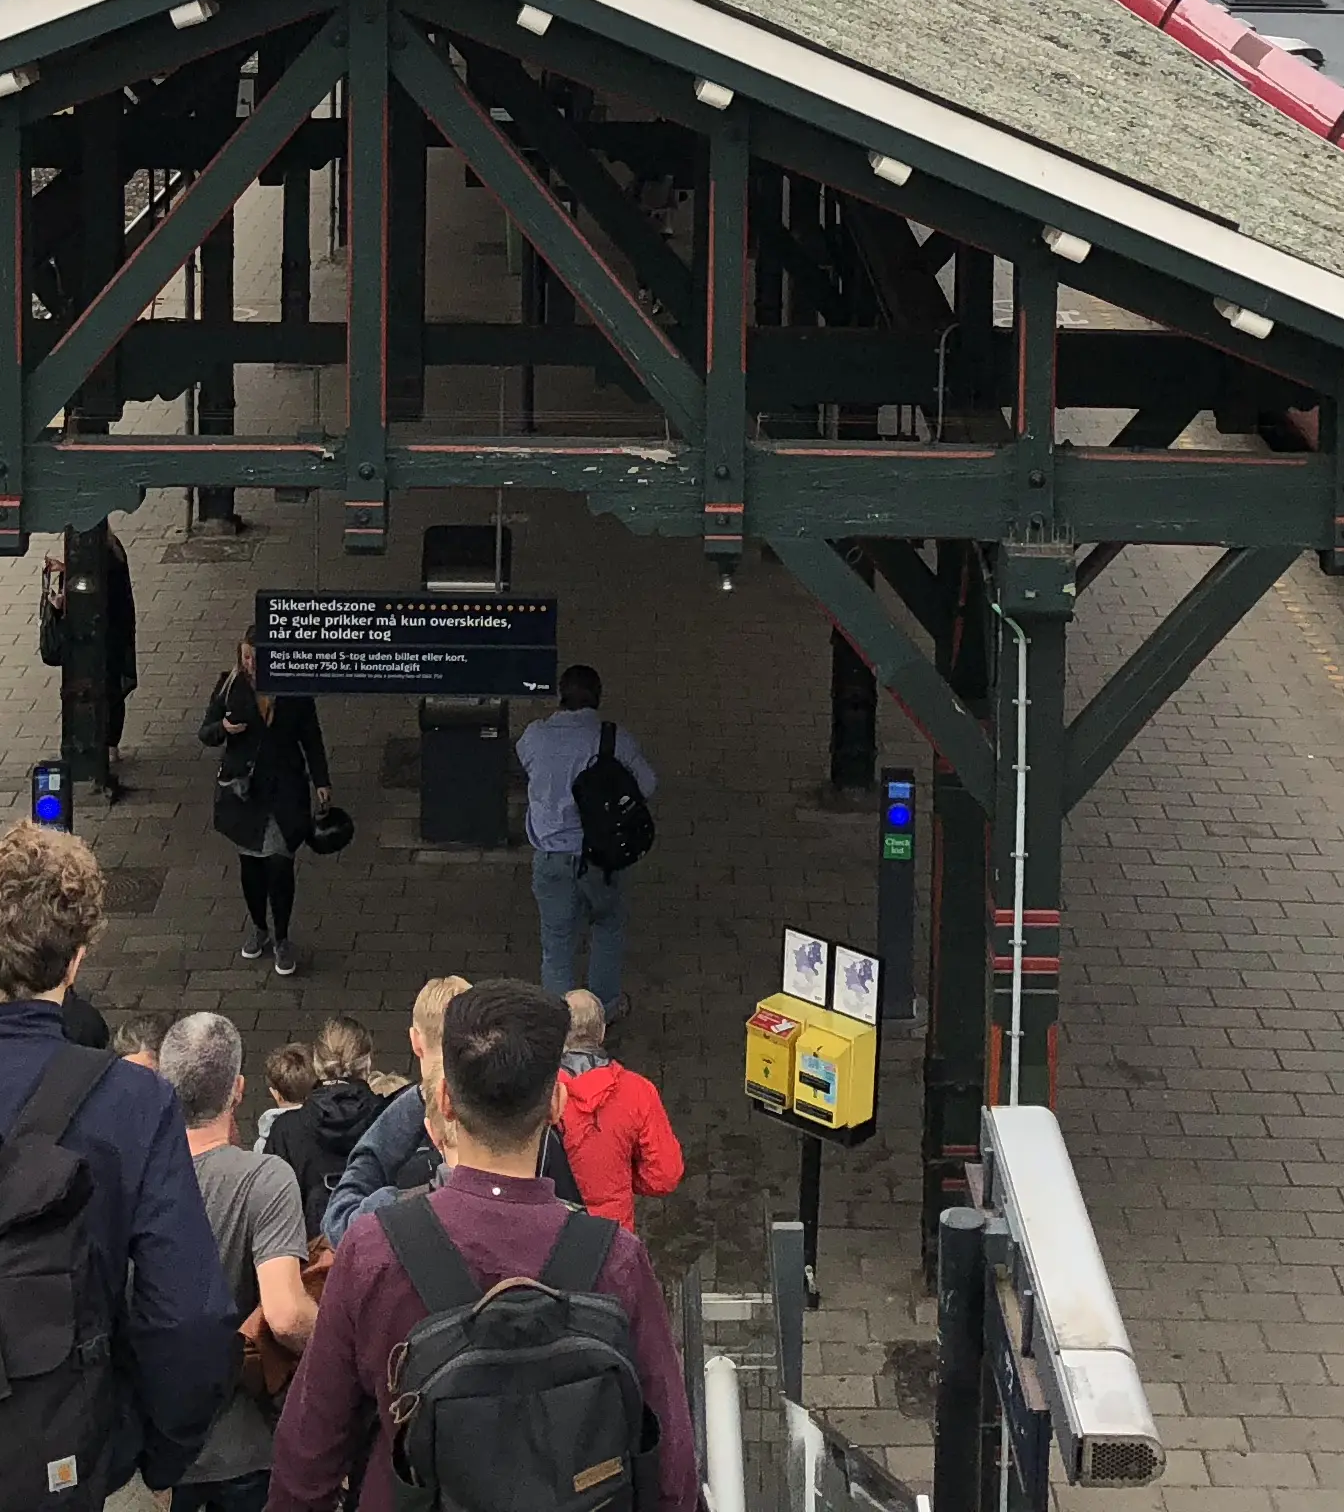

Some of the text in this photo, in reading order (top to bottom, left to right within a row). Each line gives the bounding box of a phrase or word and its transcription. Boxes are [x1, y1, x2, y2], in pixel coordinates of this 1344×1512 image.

[269, 598, 376, 612] Sikkerhedszone
[269, 613, 512, 629] De gule prikker må kun overskrides,
[269, 627, 392, 642] når der holder tog
[270, 651, 468, 663] Rejs ikke med S-tog uden billet eller kort,
[269, 661, 286, 670] det
[288, 661, 318, 670] koster
[320, 661, 338, 671] 750
[340, 662, 352, 671] kr.
[360, 662, 421, 673] kontrolafgift
